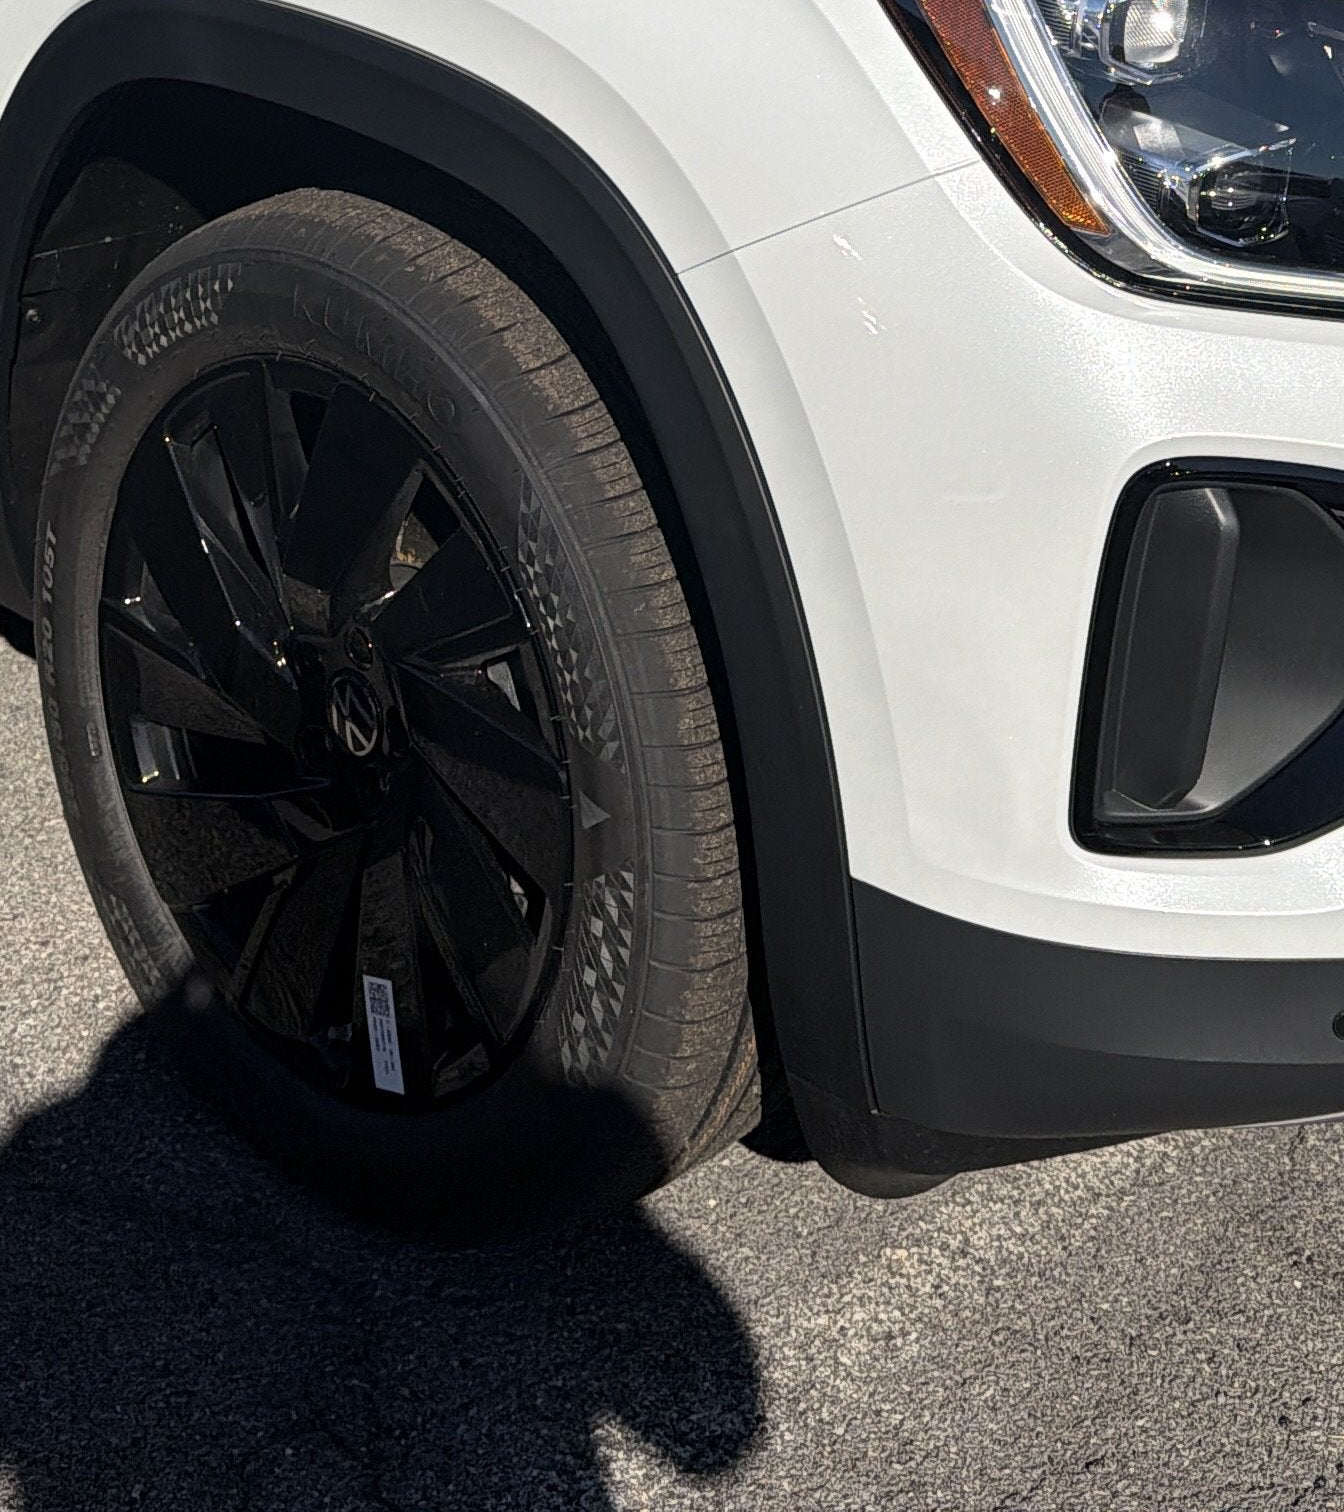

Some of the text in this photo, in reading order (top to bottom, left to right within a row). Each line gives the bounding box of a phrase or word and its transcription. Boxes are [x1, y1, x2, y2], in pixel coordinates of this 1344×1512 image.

[292, 283, 457, 426] KUMHO
[41, 519, 57, 604] 105T
[41, 616, 56, 687] R20
